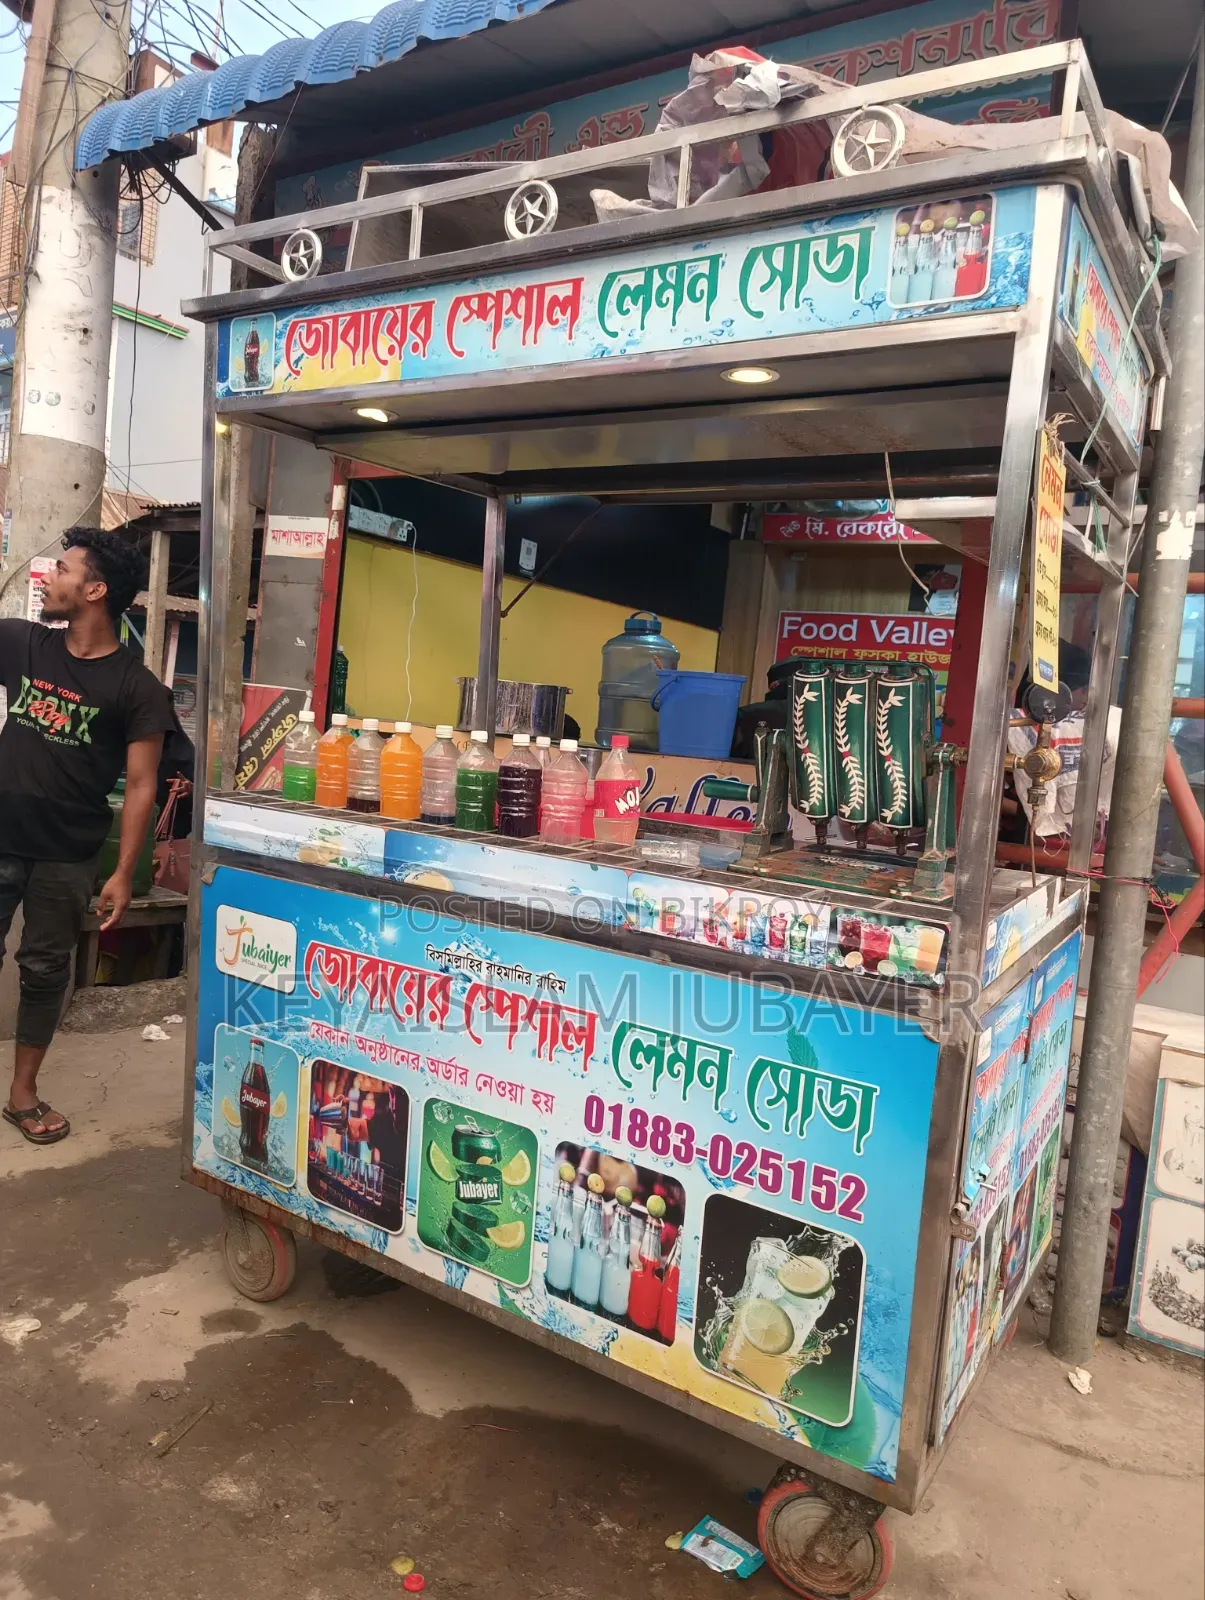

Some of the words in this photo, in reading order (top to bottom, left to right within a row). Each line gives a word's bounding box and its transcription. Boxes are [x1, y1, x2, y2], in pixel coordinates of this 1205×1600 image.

[285, 299, 436, 377] জোবায়ের
[446, 276, 585, 358] স্পেশাল
[598, 252, 723, 338] লেমন
[739, 225, 876, 319] সোডা
[782, 616, 858, 642] Food
[790, 645, 848, 660] স্পেশাল
[32, 678, 55, 691] NEW
[57, 686, 83, 703] YORK
[614, 786, 641, 815] MOJ
[223, 922, 292, 974] Jubaiyer
[536, 972, 567, 994] রাহিম
[304, 941, 453, 1031] জোবায়ের
[465, 982, 599, 1071] স্পেশাল
[612, 1020, 733, 1113] লেমন
[747, 1056, 880, 1156] সোডা
[355, 1034, 421, 1072] অনুষ্ঠানের
[426, 1056, 470, 1087] অর্ডার
[475, 1072, 525, 1106] নেওয়া
[530, 1088, 556, 1116] হয়
[240, 1084, 268, 1109] Jubayer
[584, 1094, 868, 1223] 01883-025152
[458, 1178, 499, 1199] Jubayer
